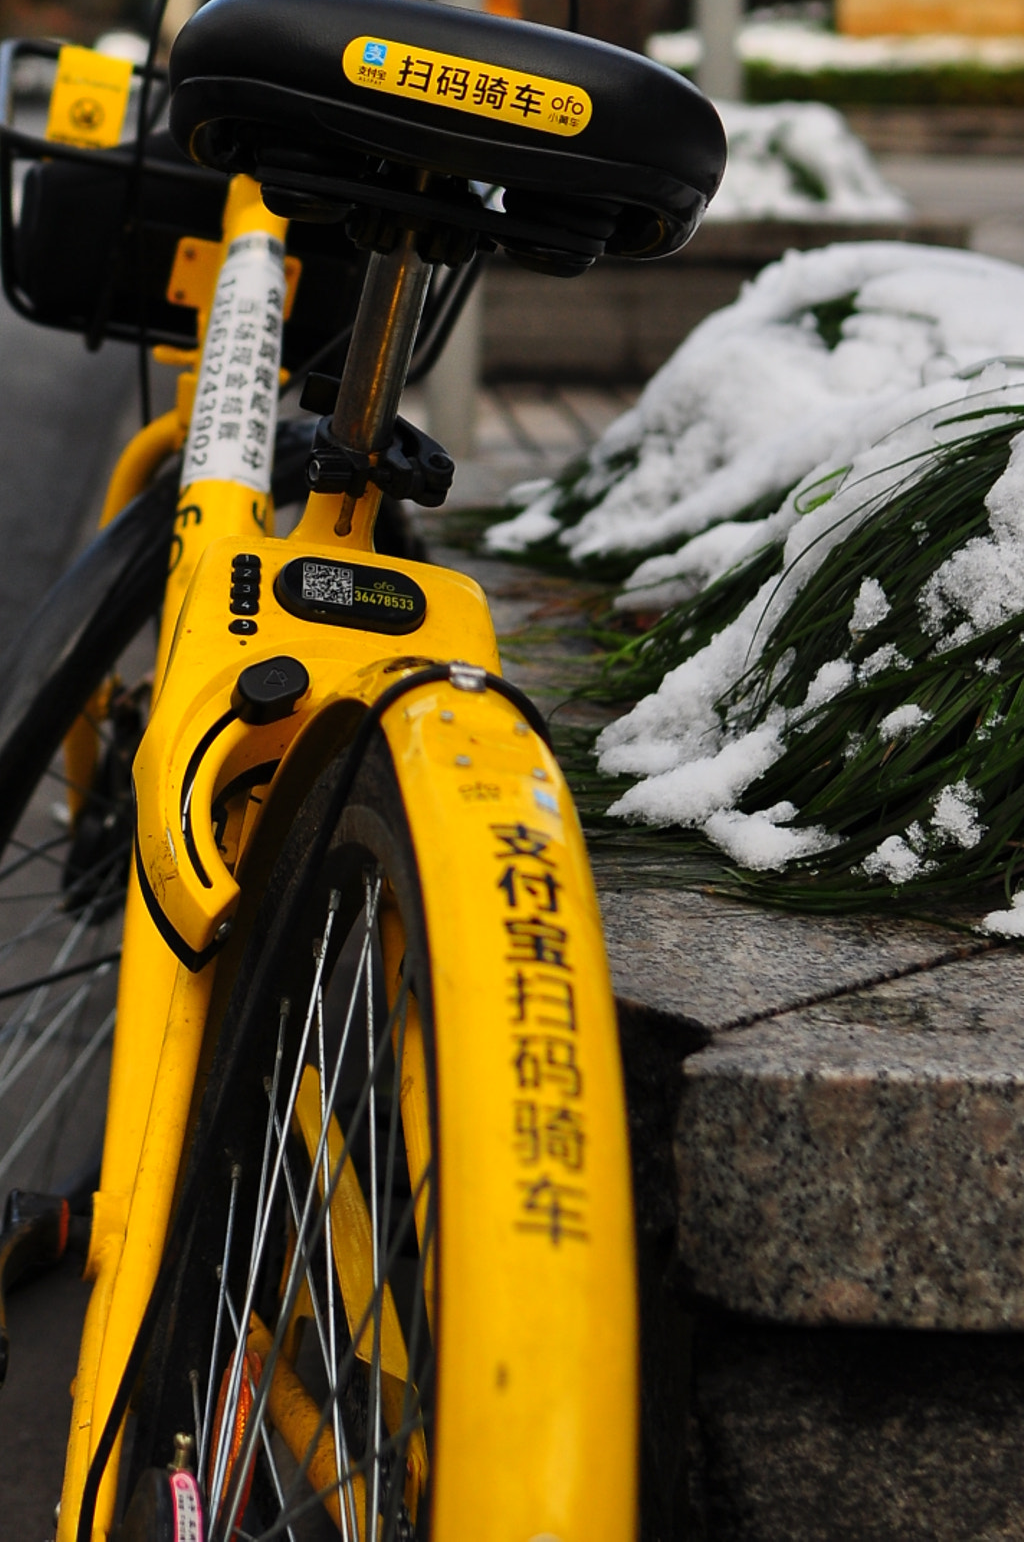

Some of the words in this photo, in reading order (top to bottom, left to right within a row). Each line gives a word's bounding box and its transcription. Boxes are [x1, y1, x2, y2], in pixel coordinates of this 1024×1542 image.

[396, 55, 546, 118] 扫码骑车
[550, 95, 585, 116] ofo
[244, 554, 250, 562] 1
[242, 567, 253, 577] 2
[242, 583, 251, 594] 3
[372, 581, 397, 592] ofo
[240, 601, 251, 609] 4
[354, 590, 415, 611] 36478533
[488, 821, 592, 1250] 支付宝扫码骑车
